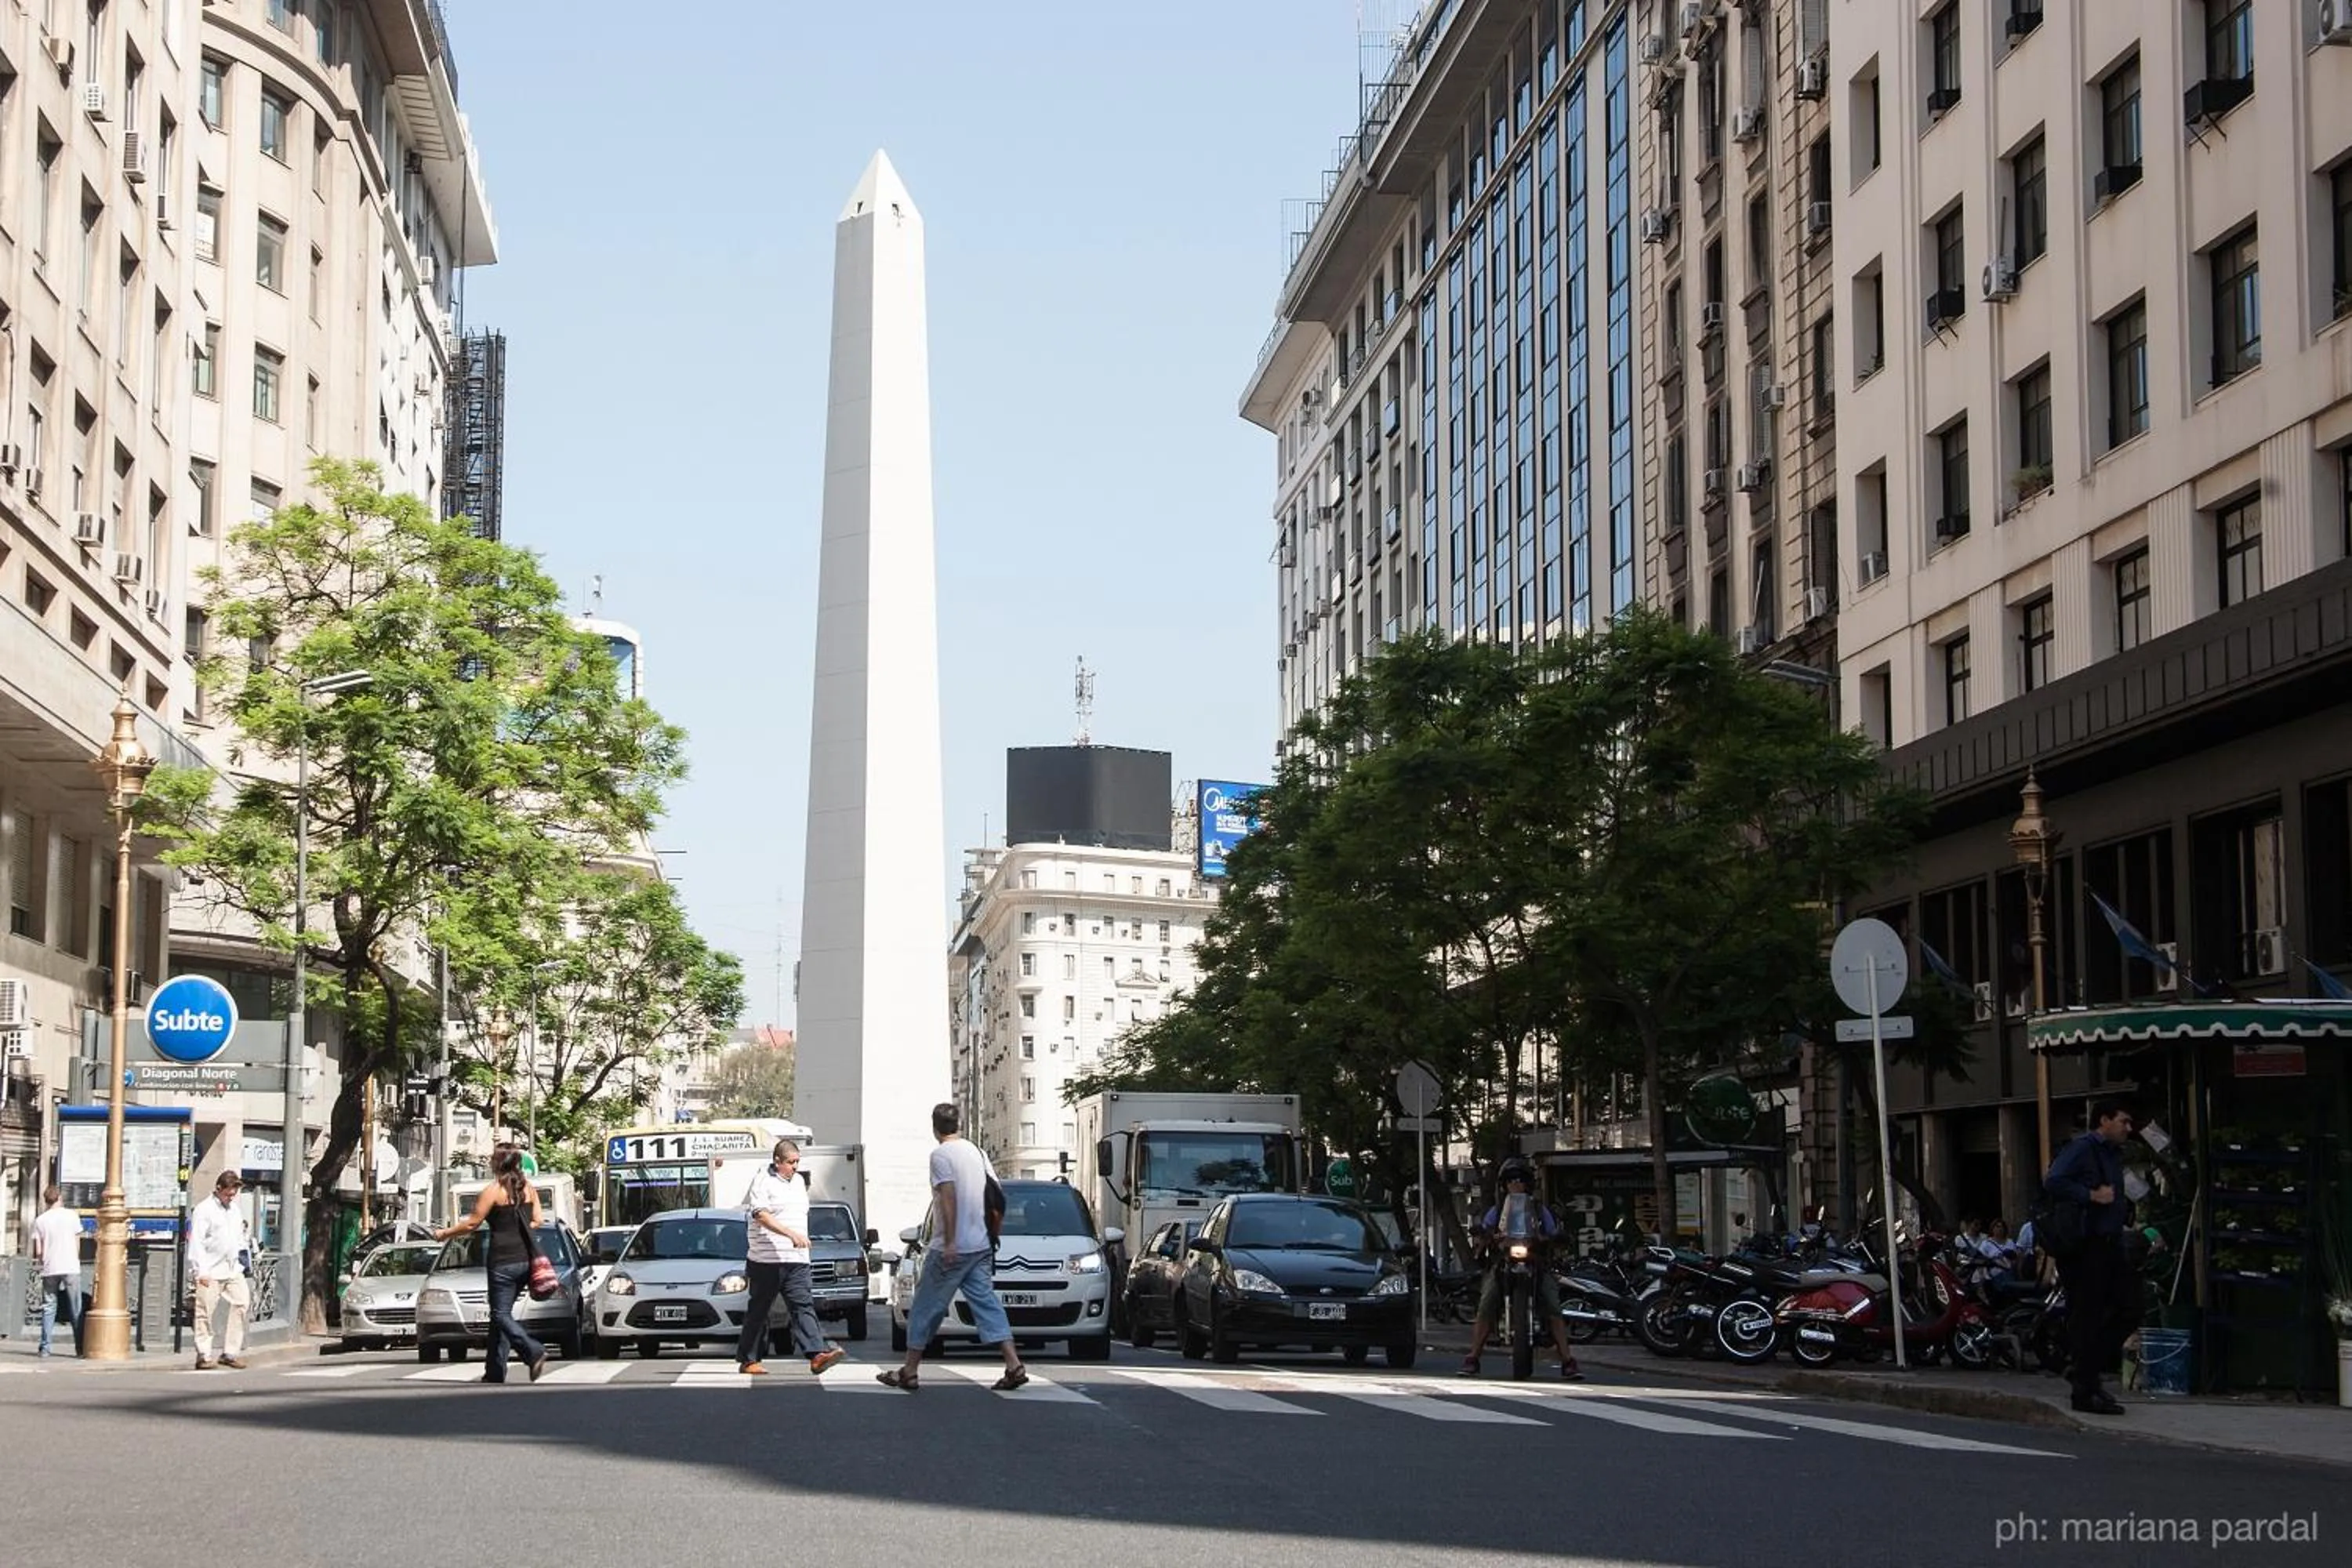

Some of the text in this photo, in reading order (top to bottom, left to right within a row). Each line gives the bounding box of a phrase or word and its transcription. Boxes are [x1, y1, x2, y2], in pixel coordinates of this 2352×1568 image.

[154, 1008, 223, 1031] Subte
[142, 1068, 238, 1080] Diagonal Norte
[628, 1138, 686, 1160] 111
[1330, 1174, 1352, 1186] Sub
